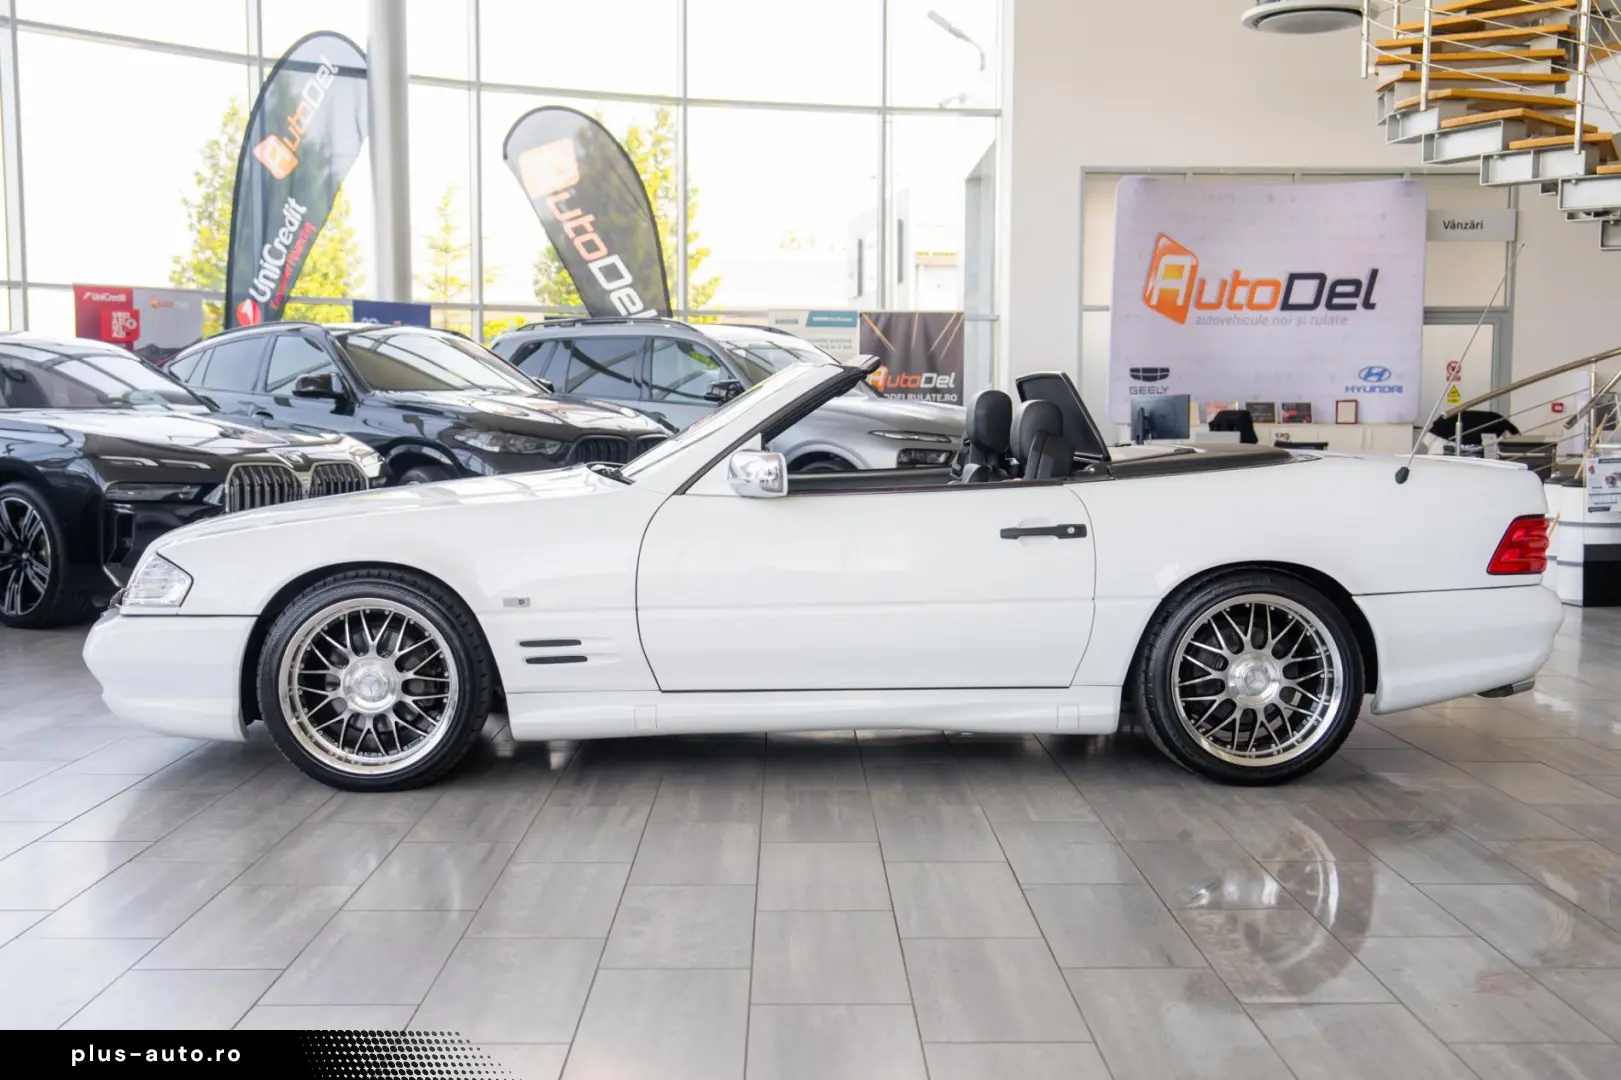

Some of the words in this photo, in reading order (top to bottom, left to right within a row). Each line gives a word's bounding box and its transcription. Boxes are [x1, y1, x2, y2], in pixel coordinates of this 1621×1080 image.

[255, 55, 339, 179] AutoDel
[522, 142, 657, 318] AutoDel
[1442, 219, 1484, 231] Vânzări
[248, 196, 307, 303] UniCredit
[1145, 243, 1380, 318] AutoDel
[1195, 313, 1269, 326] autovehicule
[1272, 314, 1292, 326] noi
[1309, 313, 1349, 326] rulate
[867, 366, 956, 391] AutoDel
[1129, 386, 1170, 395] GEELY
[1344, 384, 1404, 393] HYUNDAI
